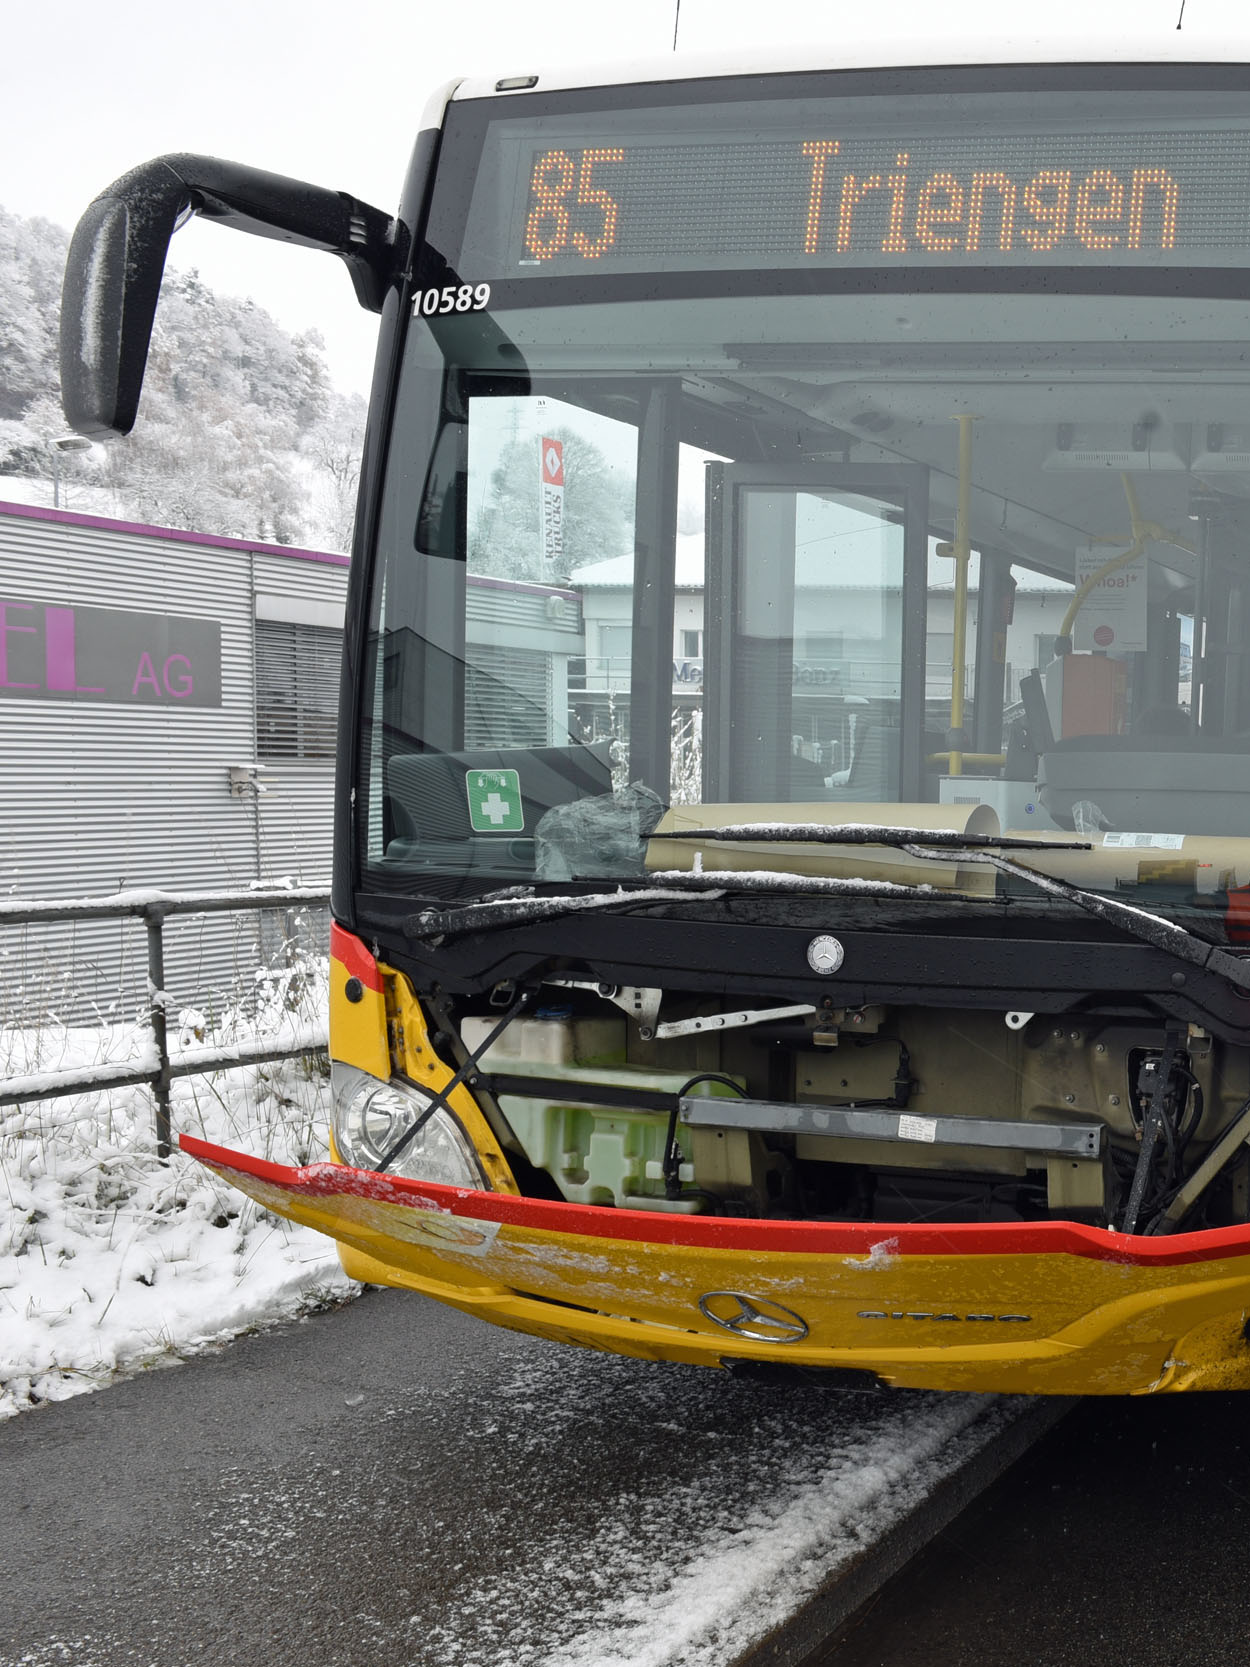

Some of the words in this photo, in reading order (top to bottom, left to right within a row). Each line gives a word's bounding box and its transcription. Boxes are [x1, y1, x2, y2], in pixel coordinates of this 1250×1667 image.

[525, 149, 624, 259] 85
[802, 140, 1179, 253] Triengen
[411, 283, 491, 316] 10589
[132, 652, 193, 697] AG
